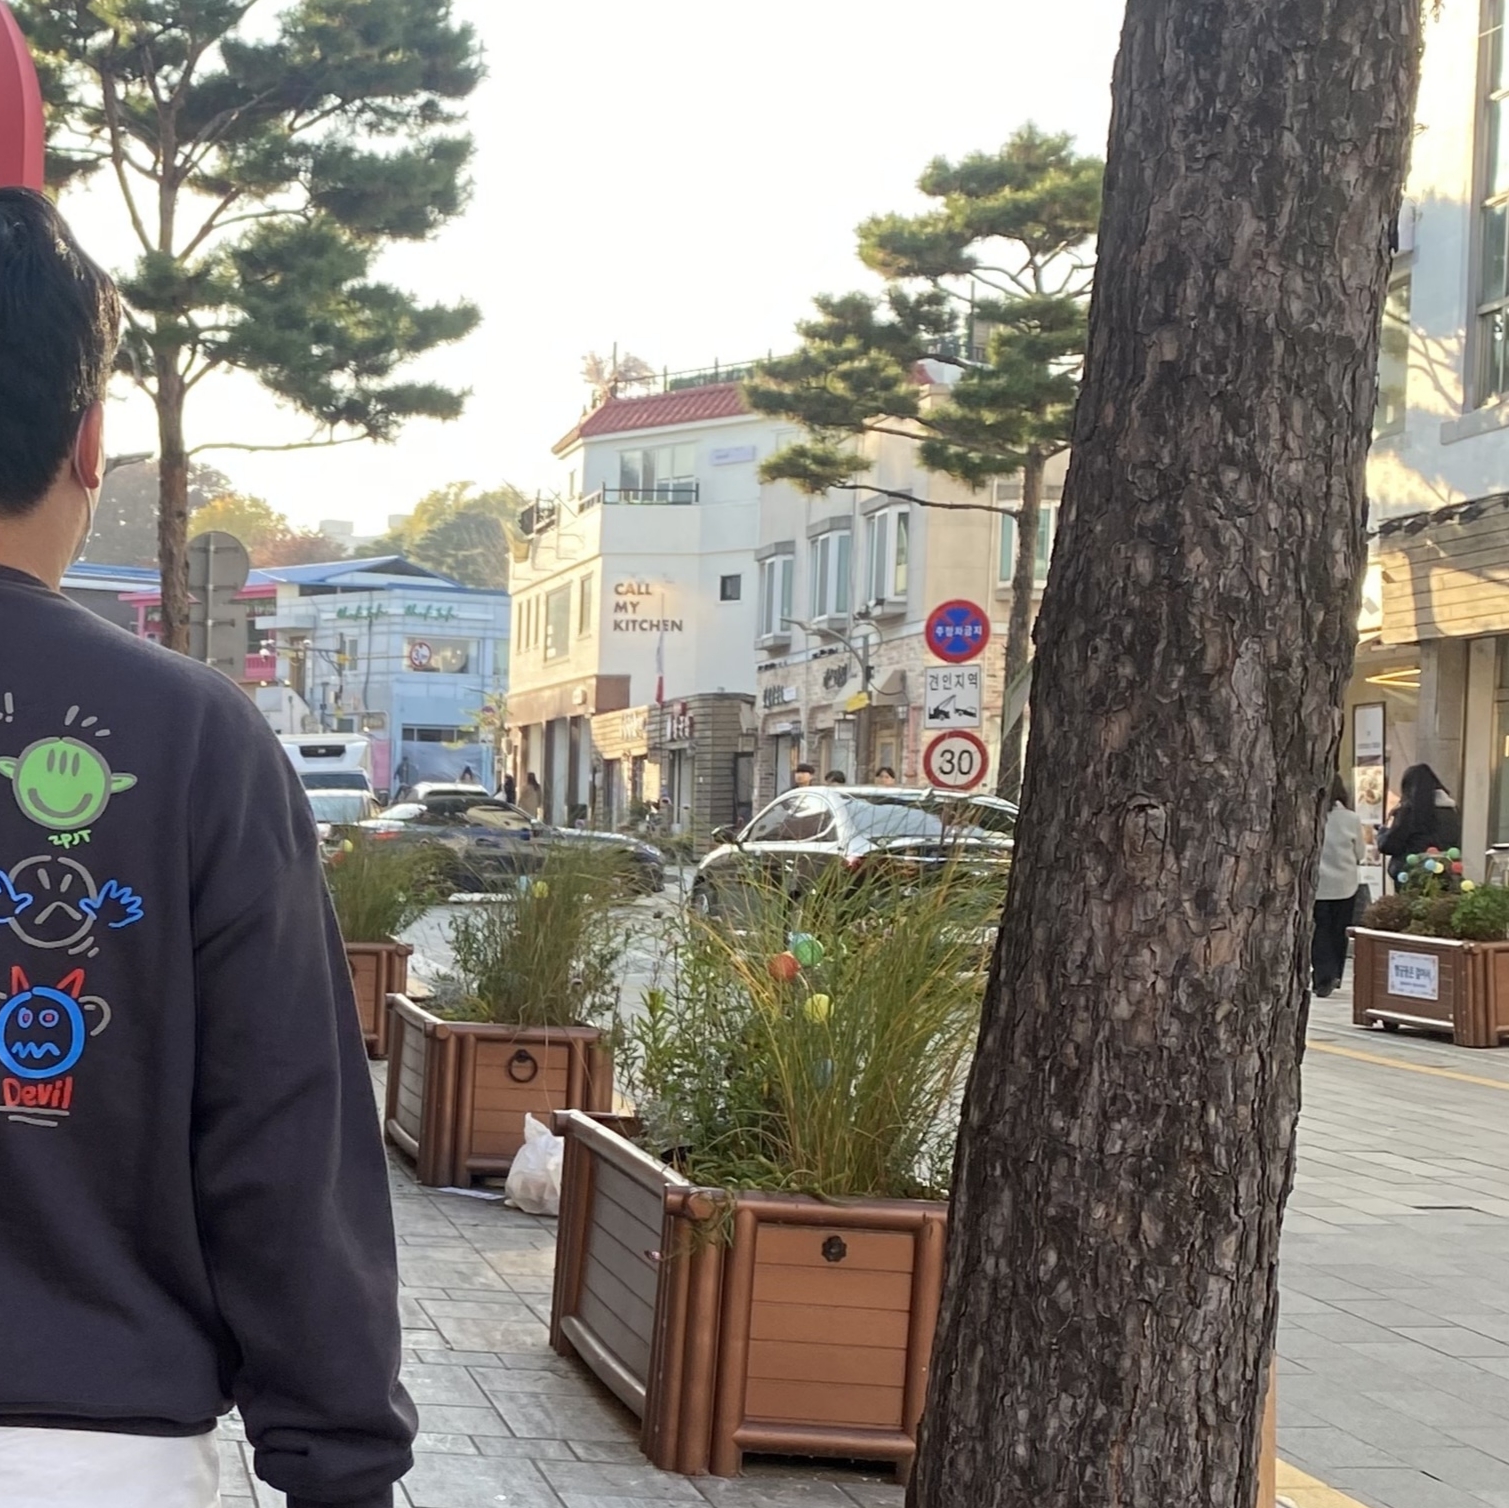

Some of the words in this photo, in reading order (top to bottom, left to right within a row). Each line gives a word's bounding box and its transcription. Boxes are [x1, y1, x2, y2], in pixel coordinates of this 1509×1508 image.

[614, 583, 653, 596] CALL
[613, 601, 640, 614] MY
[613, 619, 684, 632] KITCHEN
[929, 672, 979, 692] 견인지역
[938, 749, 974, 775] 30
[2, 1076, 73, 1109] Devil
